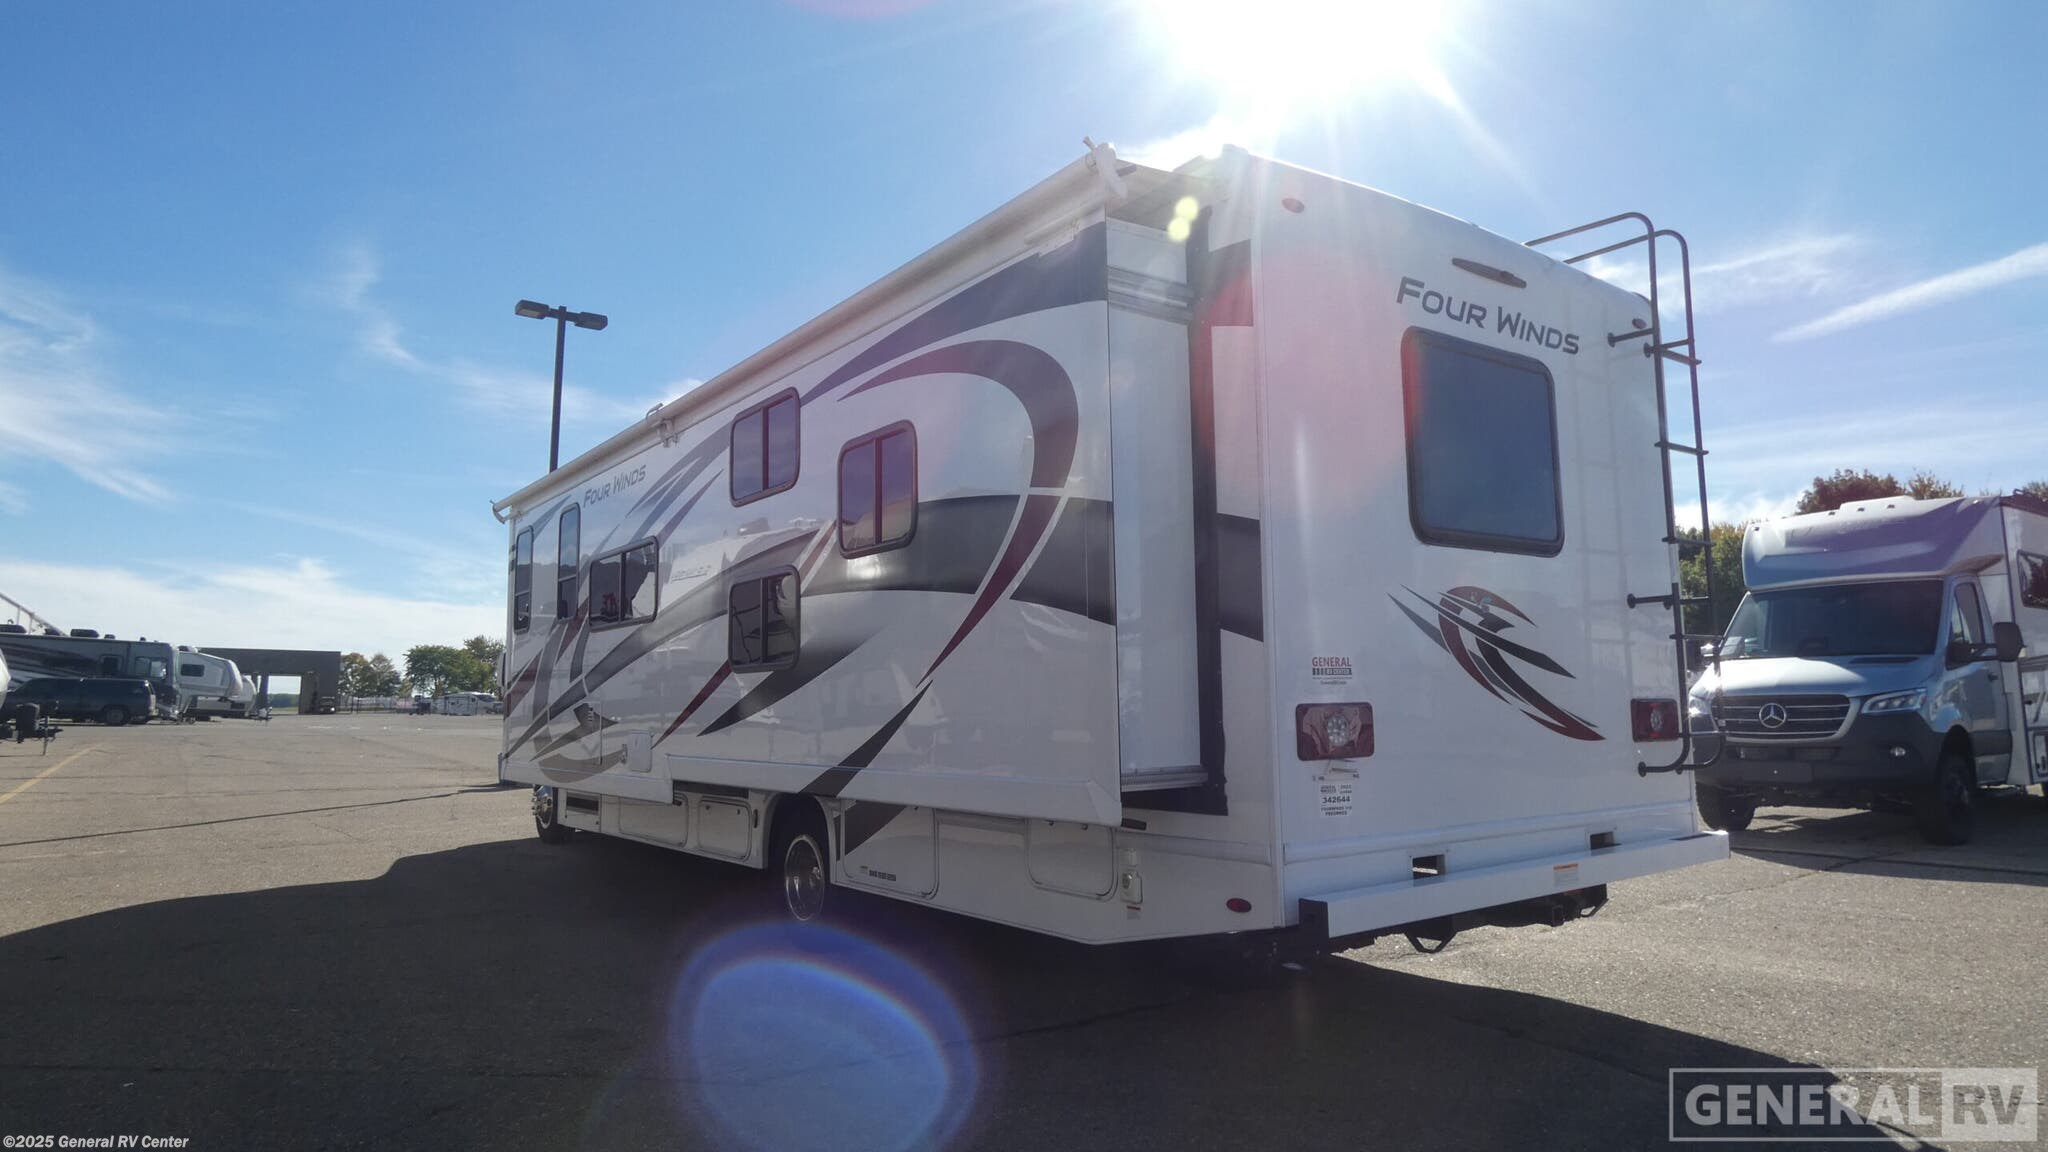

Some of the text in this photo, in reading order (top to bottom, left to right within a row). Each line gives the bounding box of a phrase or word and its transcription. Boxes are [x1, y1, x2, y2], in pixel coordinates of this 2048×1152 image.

[1396, 276, 1580, 355] FOUR WINDS
[583, 464, 647, 508] FOUR WINDS
[1312, 656, 1352, 667] GENERAL
